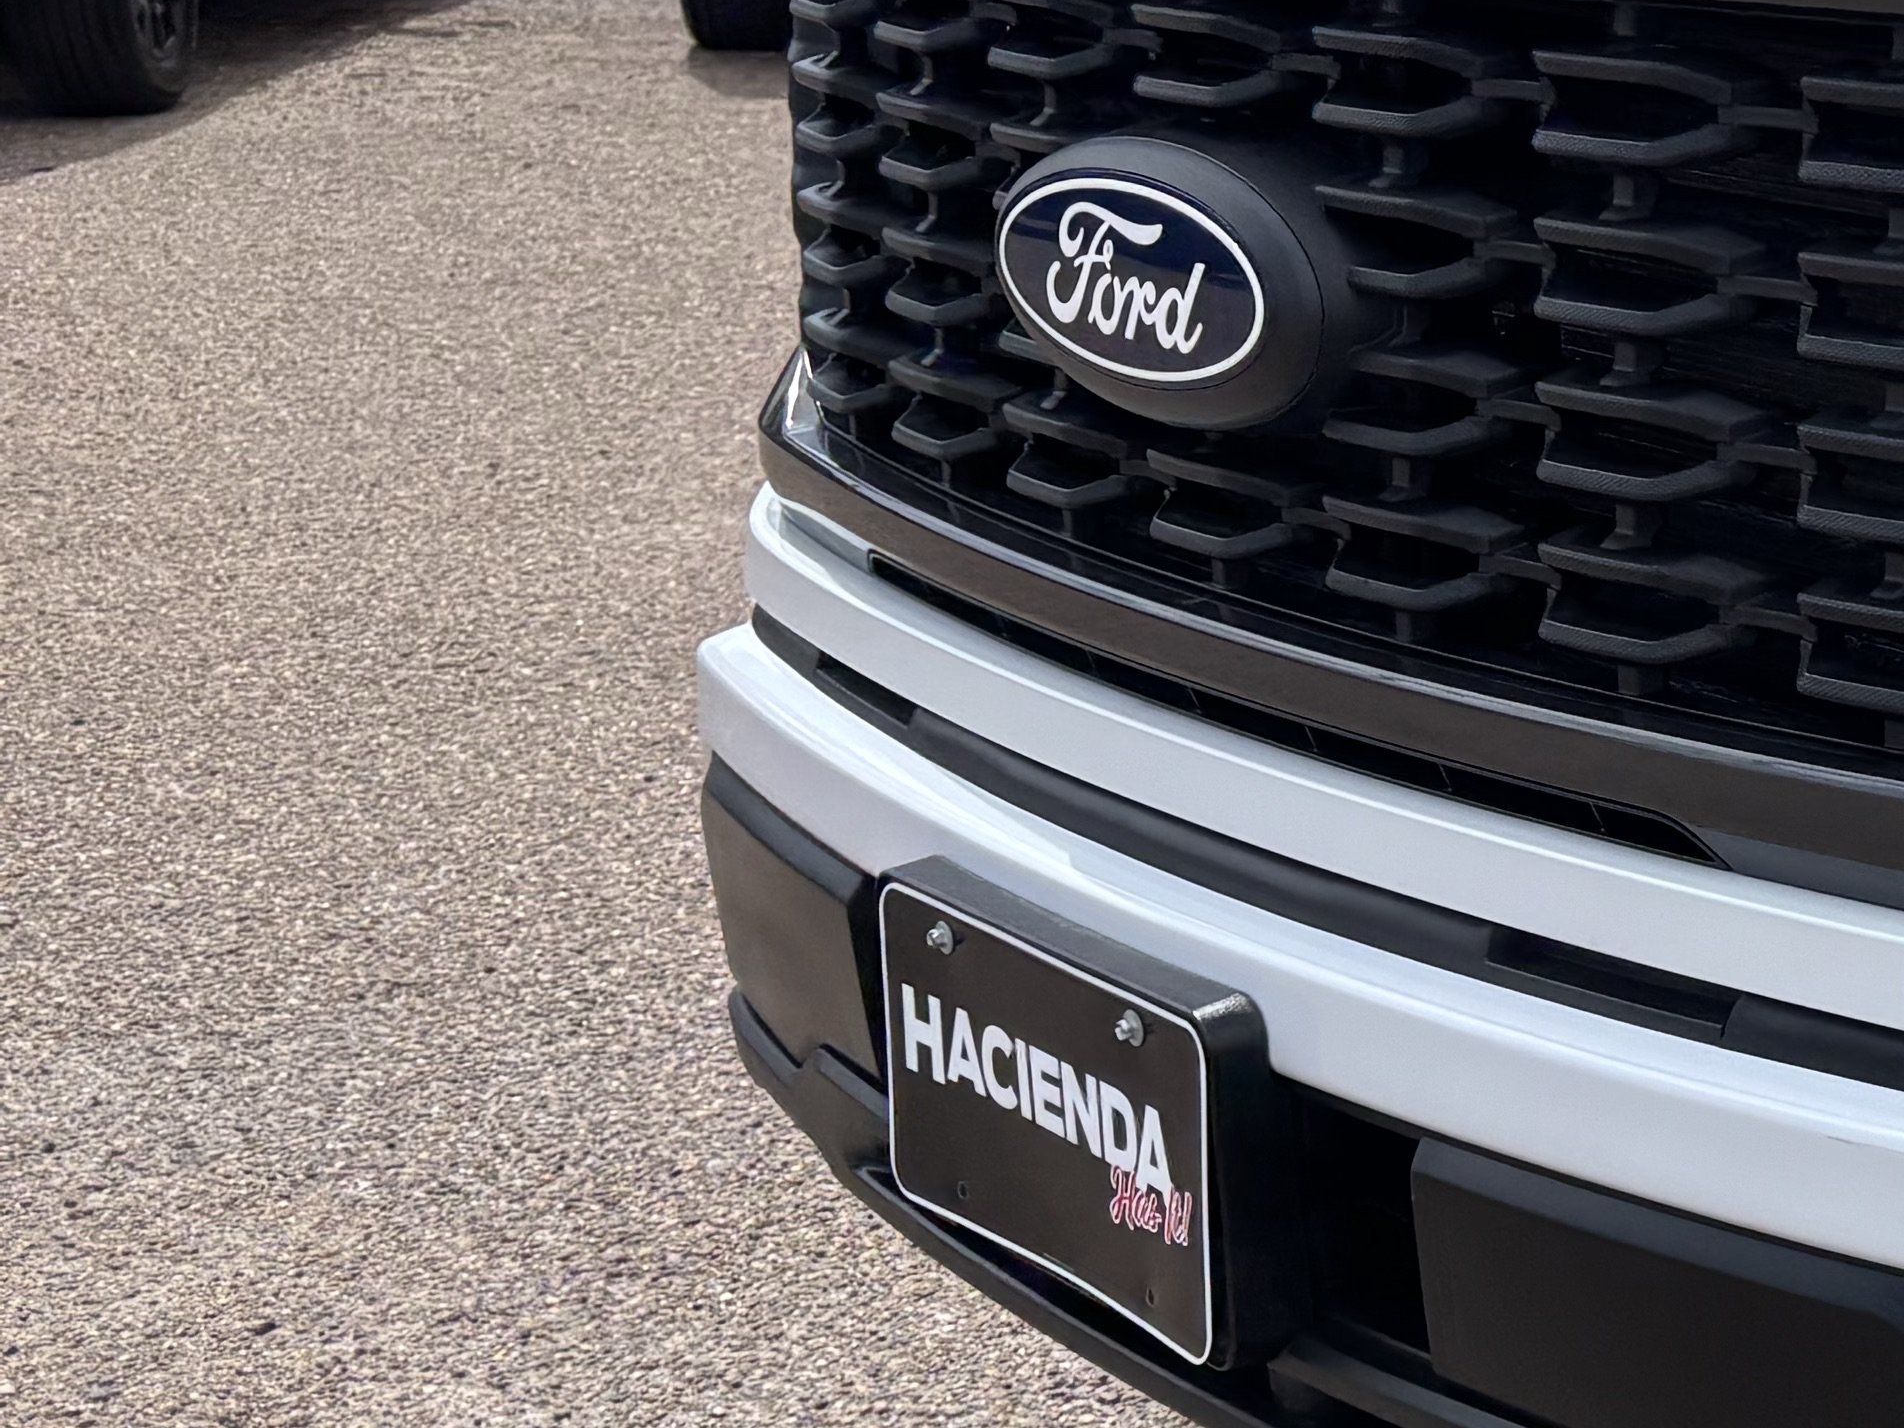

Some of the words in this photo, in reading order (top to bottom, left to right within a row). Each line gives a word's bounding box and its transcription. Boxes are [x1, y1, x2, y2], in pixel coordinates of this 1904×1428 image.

[1046, 201, 1206, 354] Ford
[901, 983, 1174, 1194] HACIENDA
[1110, 1167, 1162, 1233] Has
